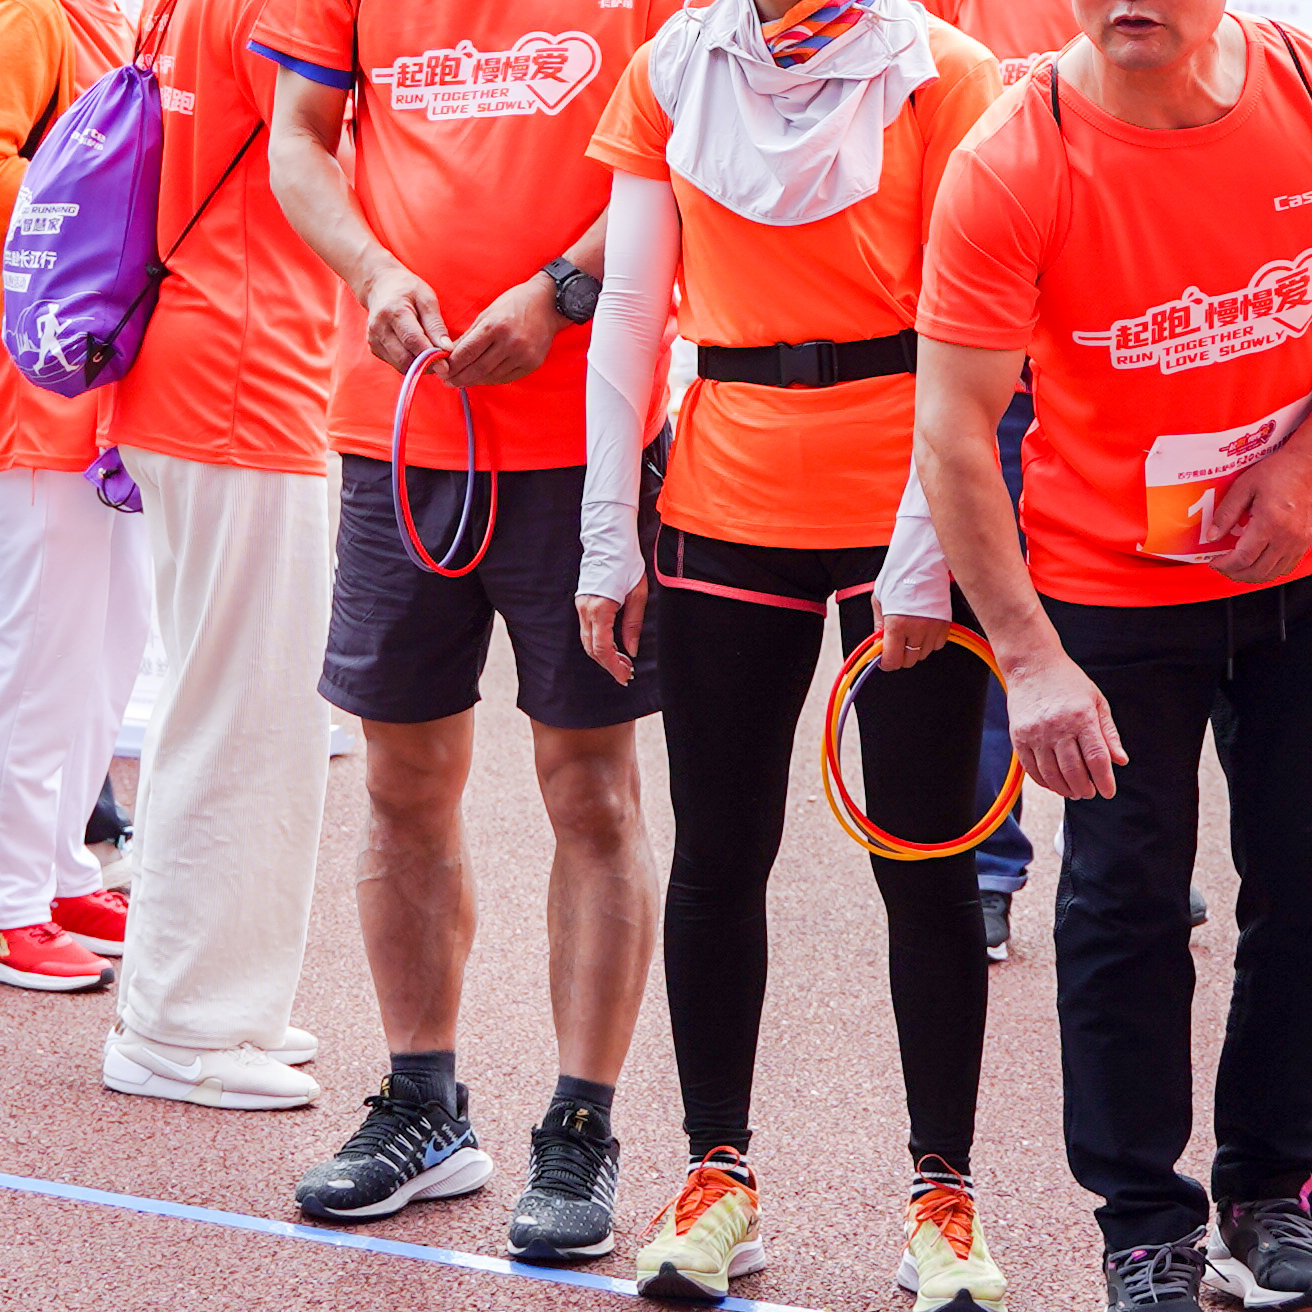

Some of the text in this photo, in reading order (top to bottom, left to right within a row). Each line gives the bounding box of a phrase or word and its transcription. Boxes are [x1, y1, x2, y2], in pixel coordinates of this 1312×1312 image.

[395, 87, 510, 105] RUN TOGETHER
[431, 99, 537, 116] LOVE SLOWLY
[1116, 325, 1254, 365] RUN TOGETHER
[1165, 329, 1285, 369] LOVE SLOWLY
